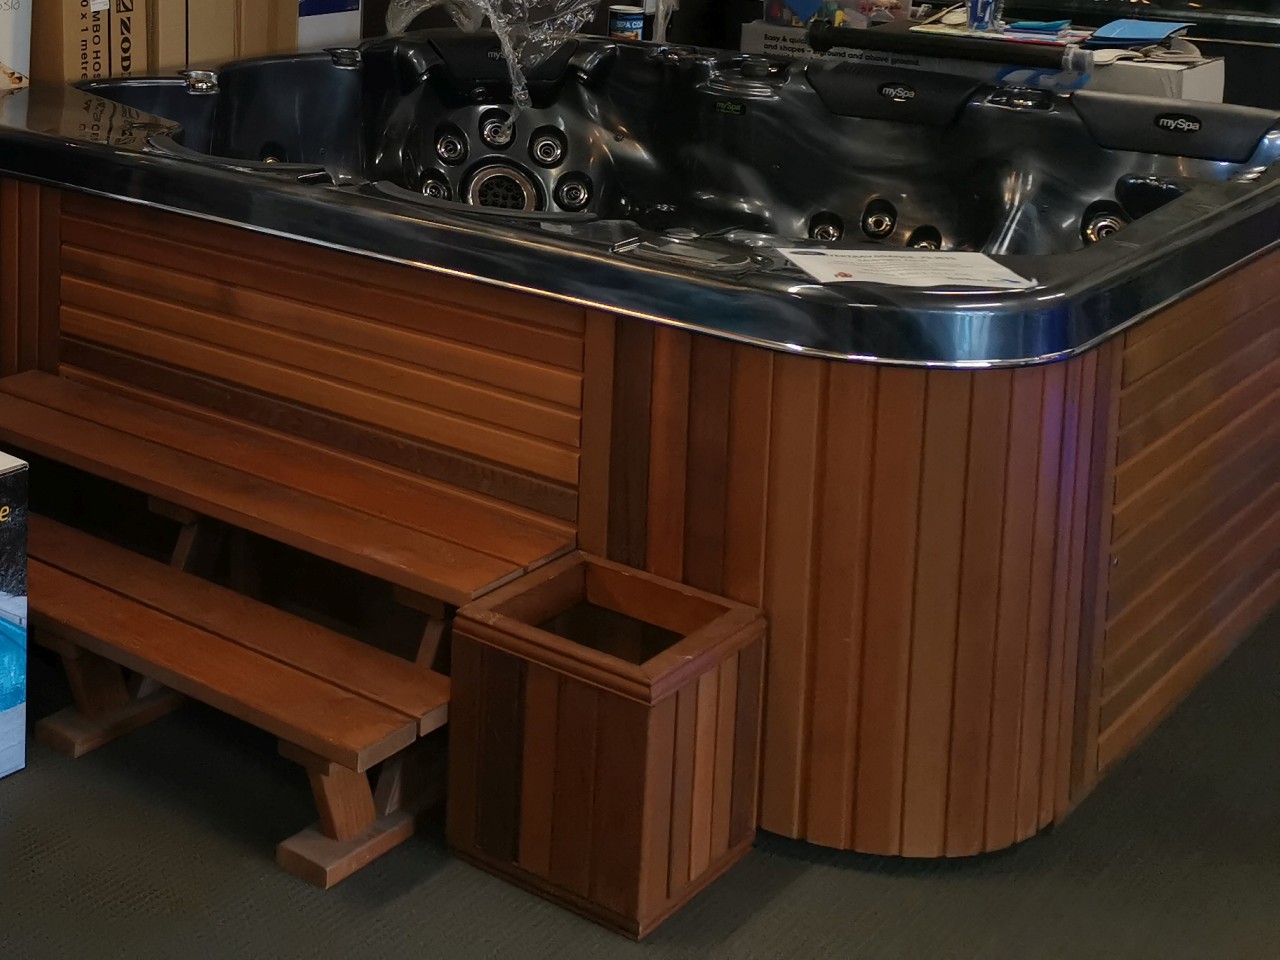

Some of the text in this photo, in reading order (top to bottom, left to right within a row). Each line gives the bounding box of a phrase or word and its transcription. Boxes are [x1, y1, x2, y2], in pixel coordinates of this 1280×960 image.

[92, 11, 101, 79] MBO HOS
[789, 36, 807, 45] quic
[764, 43, 778, 51] and
[780, 44, 806, 54] shapes
[848, 52, 864, 60] and
[865, 54, 889, 63] above
[891, 56, 919, 66] ground
[883, 86, 916, 99] mySpa
[717, 102, 741, 113] mySpa
[1159, 118, 1200, 131] mySpa
